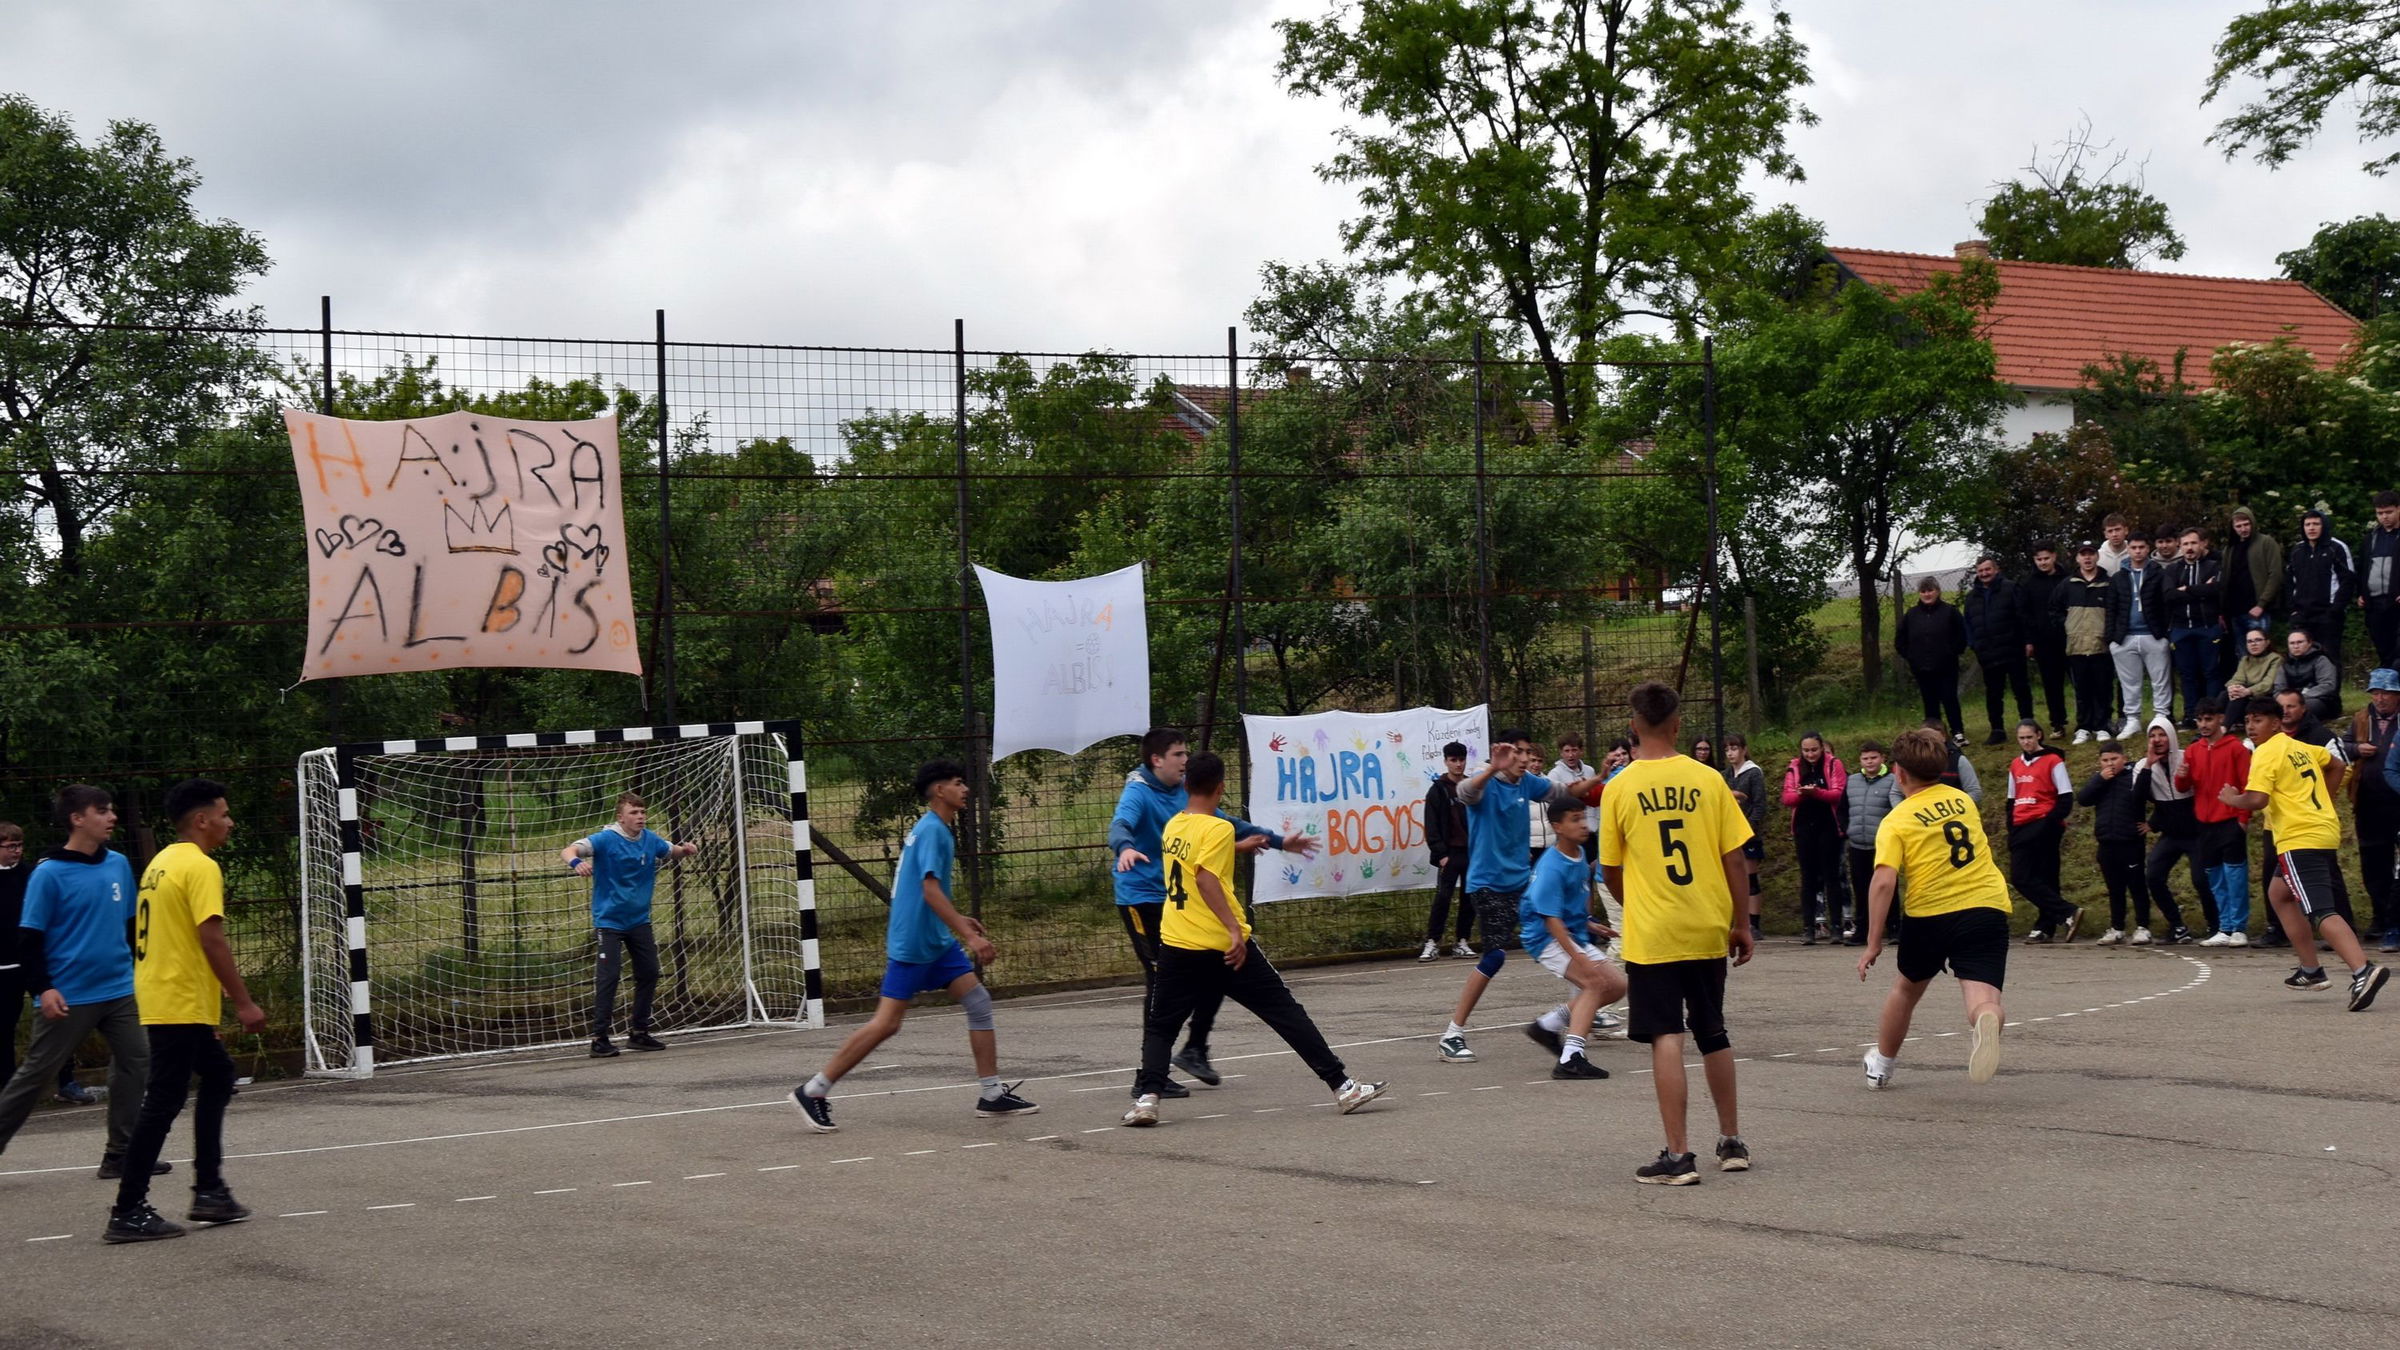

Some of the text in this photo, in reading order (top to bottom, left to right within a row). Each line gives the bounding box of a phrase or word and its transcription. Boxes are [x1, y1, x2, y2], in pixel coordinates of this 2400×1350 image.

[1637, 786, 1701, 816] ALBIS
[2300, 769, 2322, 810] 7
[1914, 798, 1966, 827] ALBIS
[1658, 819, 1694, 886] 5
[1943, 821, 1976, 869] 8
[112, 882, 121, 901] 3
[1168, 859, 1188, 910] 4
